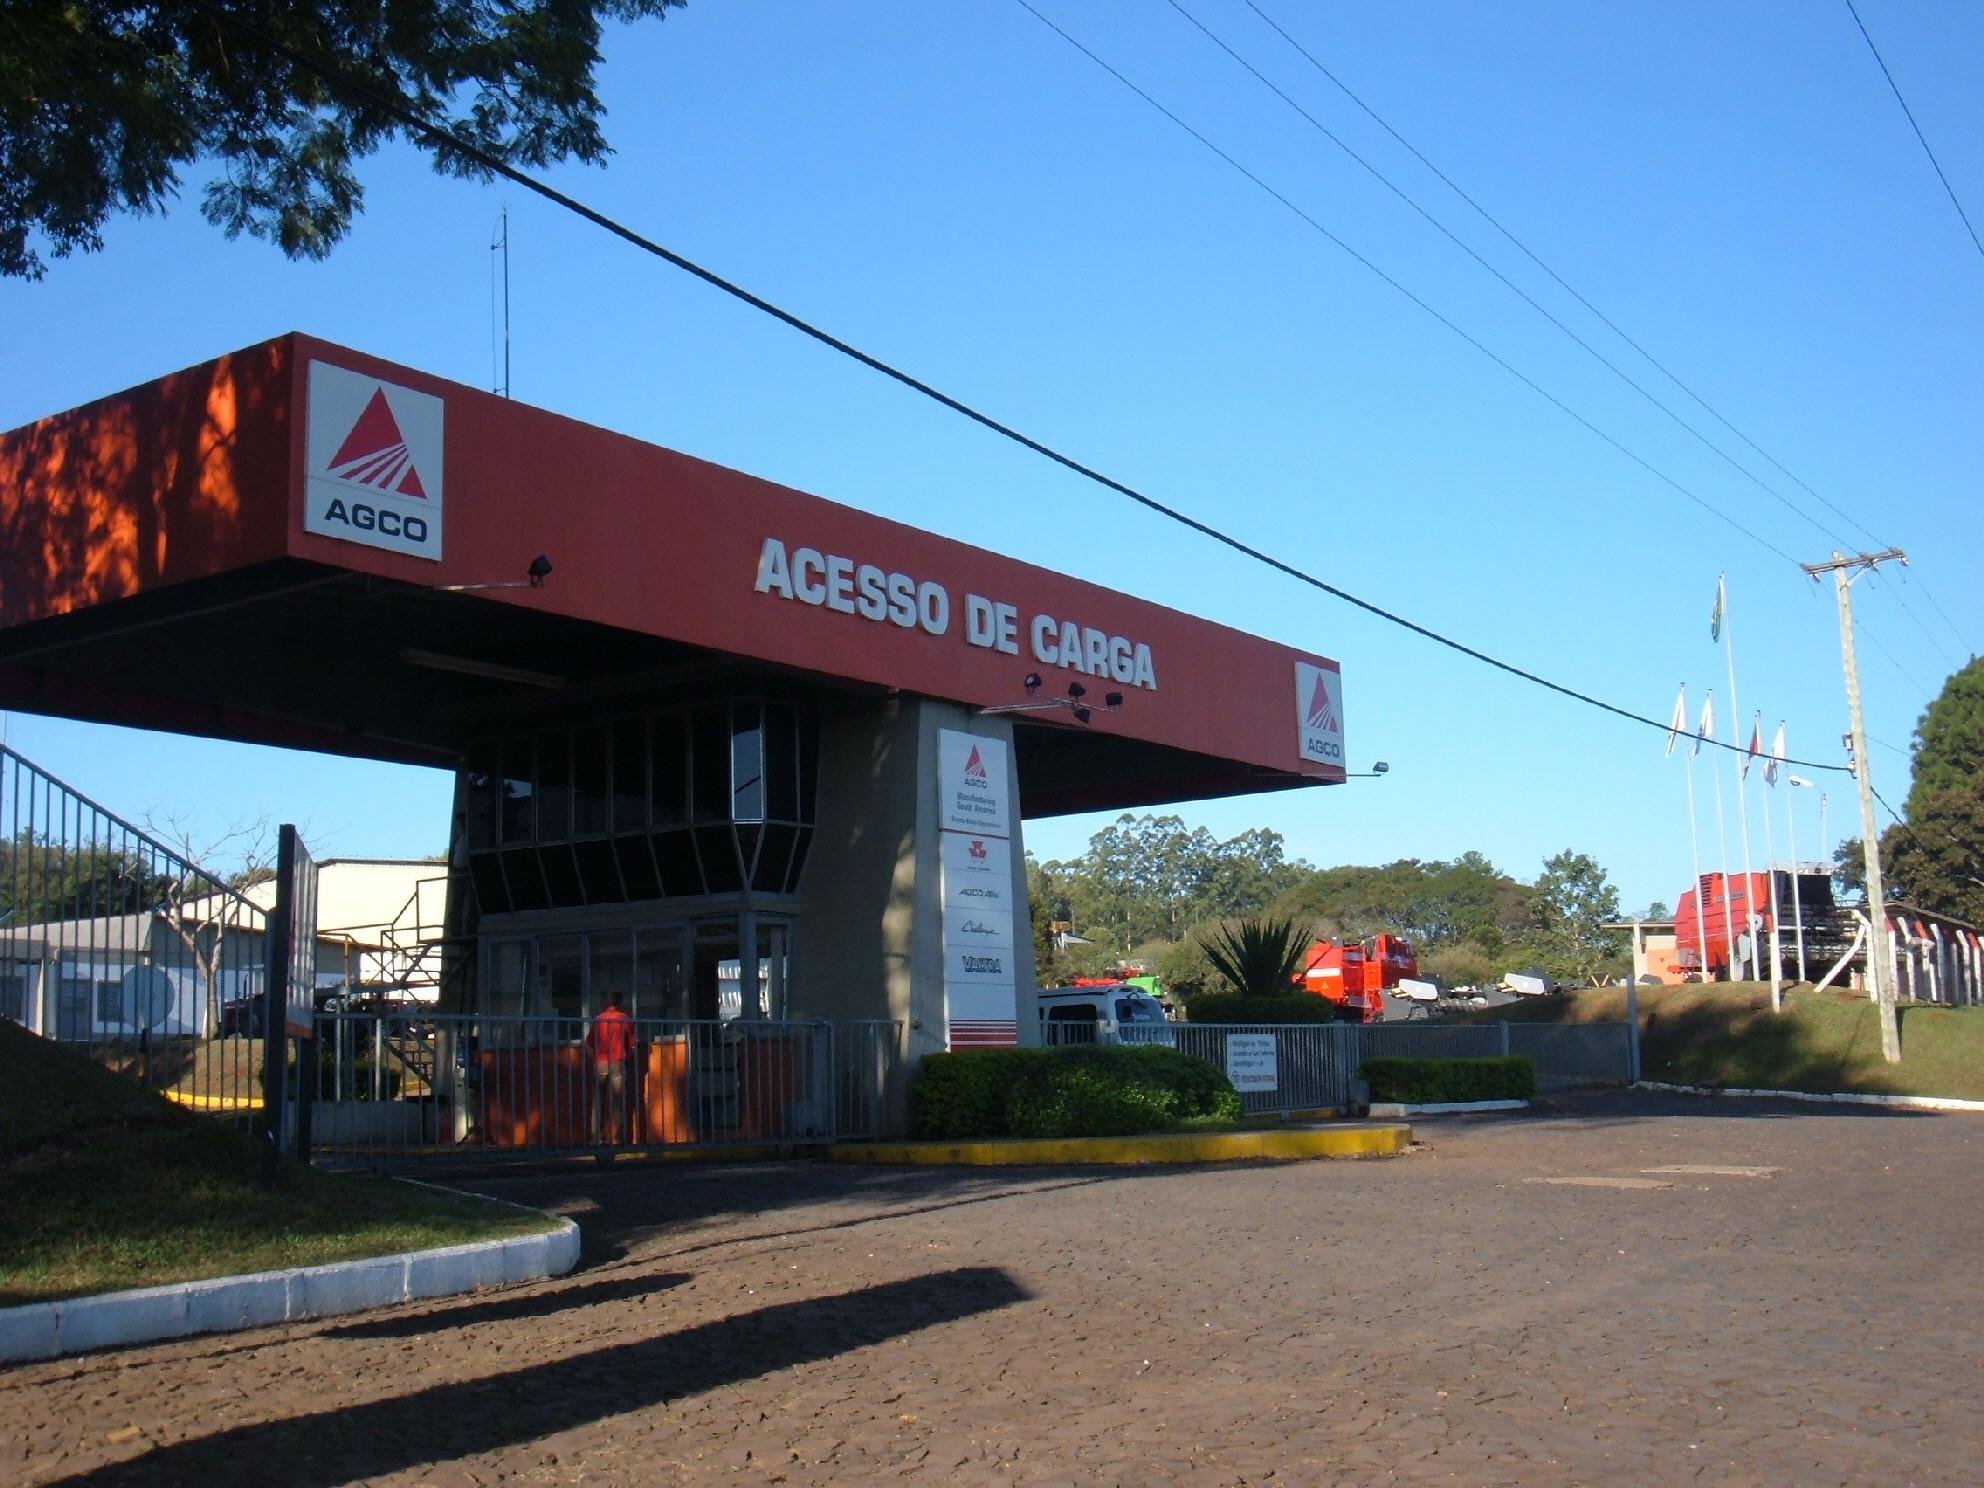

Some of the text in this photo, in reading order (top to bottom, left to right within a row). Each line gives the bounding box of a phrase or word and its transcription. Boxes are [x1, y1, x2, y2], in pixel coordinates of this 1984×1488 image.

[325, 498, 427, 542] AGCO
[754, 538, 1157, 691] ACESSO DE CARGA
[1308, 739, 1340, 758] AGCO
